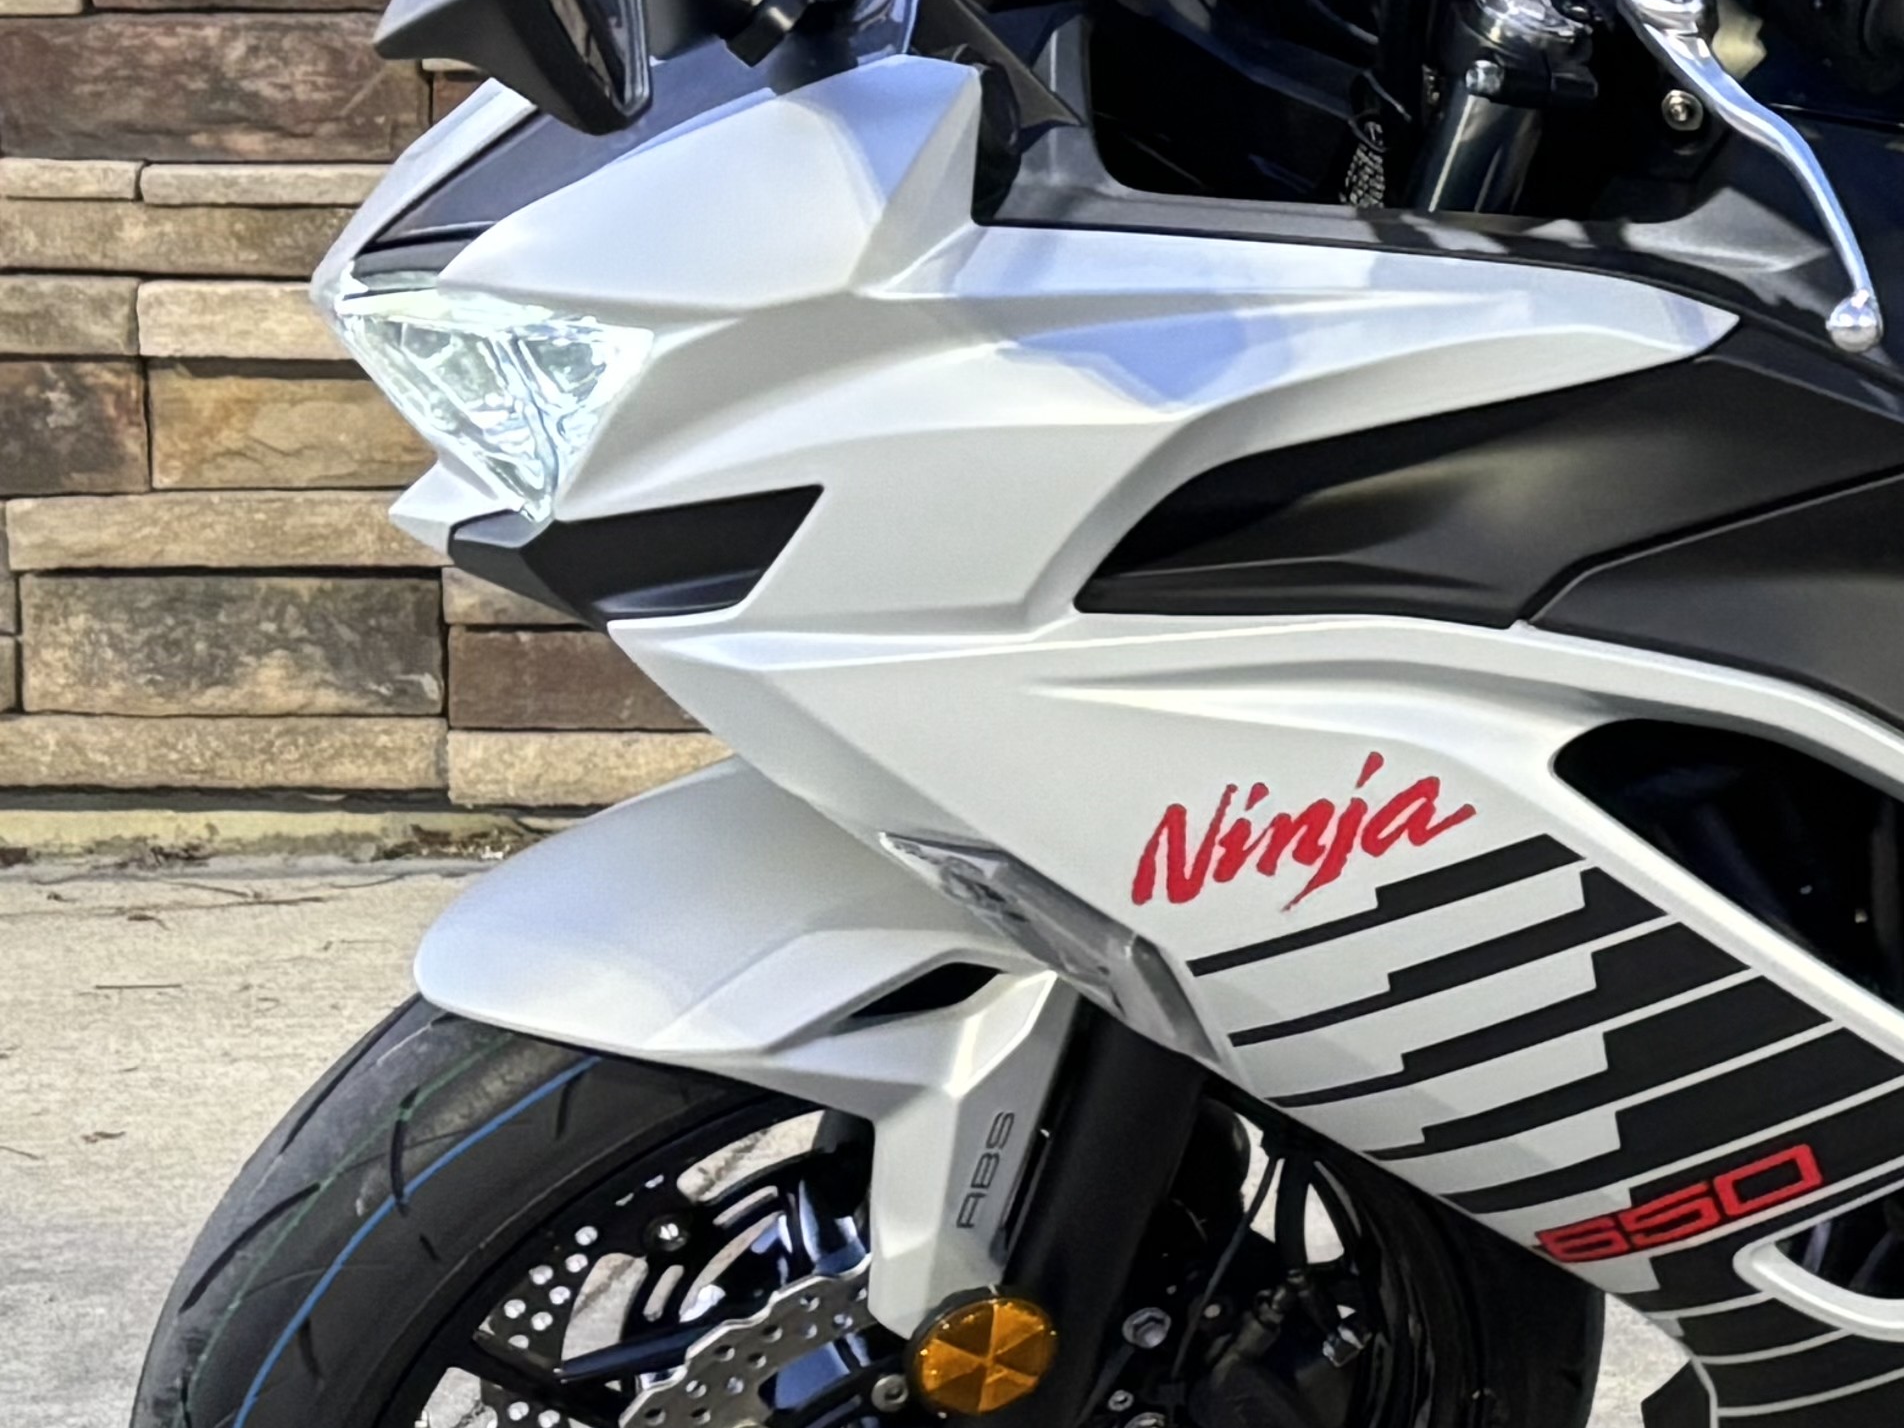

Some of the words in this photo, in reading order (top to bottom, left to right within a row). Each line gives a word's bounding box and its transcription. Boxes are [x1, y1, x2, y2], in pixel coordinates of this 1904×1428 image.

[1131, 751, 1477, 912] Ninja
[956, 1111, 1015, 1229] ABS
[1535, 1143, 1823, 1263] 650
